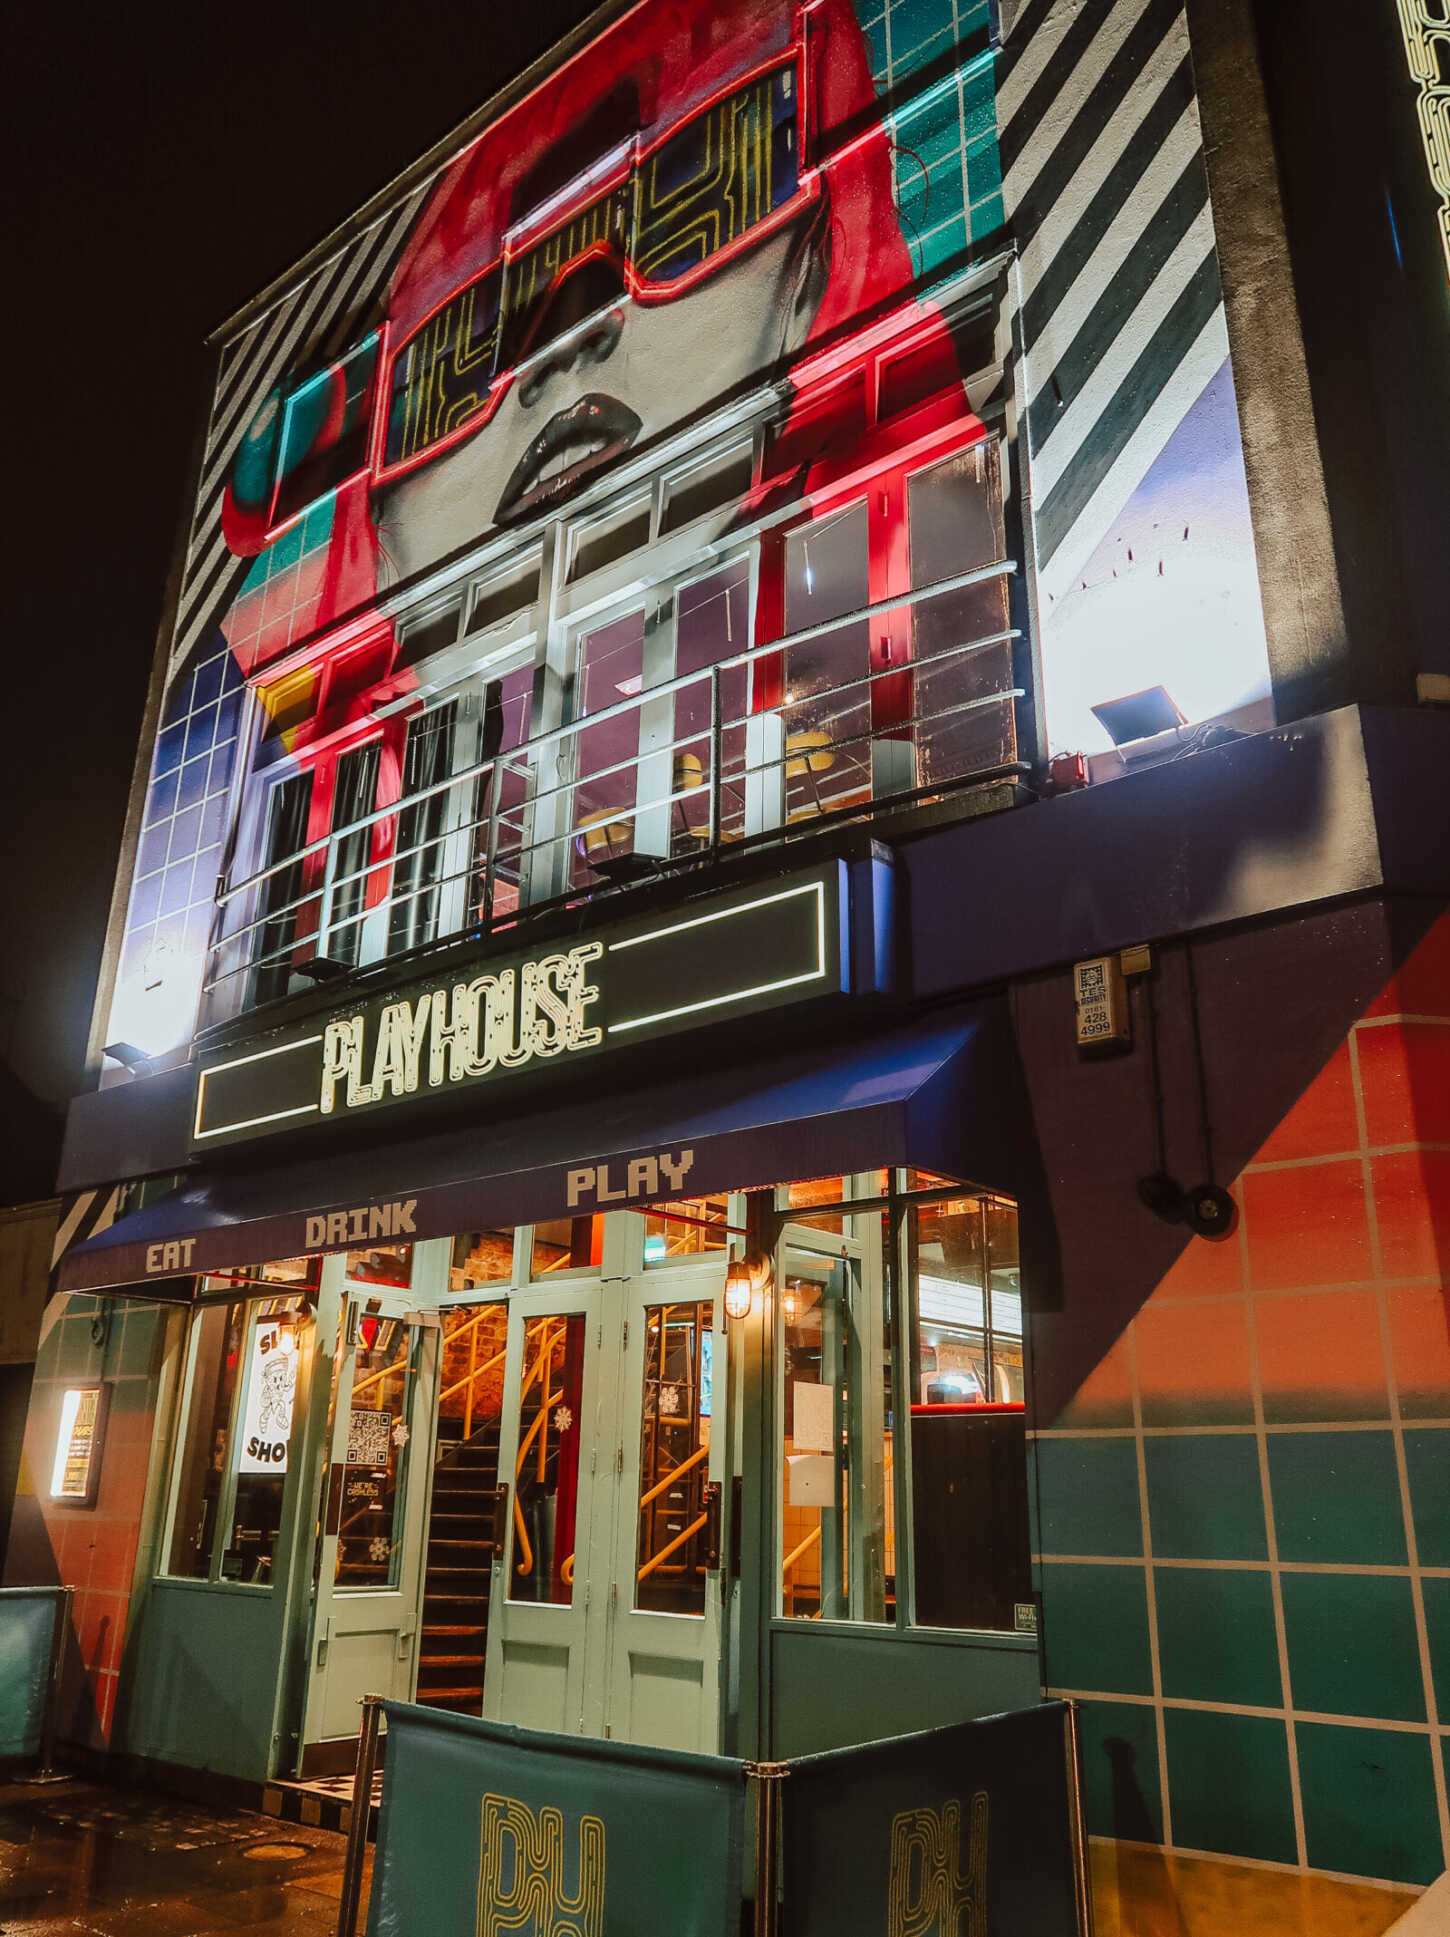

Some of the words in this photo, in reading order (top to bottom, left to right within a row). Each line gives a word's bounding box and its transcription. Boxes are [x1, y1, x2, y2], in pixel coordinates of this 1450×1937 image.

[320, 941, 603, 1114] PLAYHOUSE
[1080, 1021, 1110, 1036] 4999
[1084, 1011, 1107, 1024] 428
[145, 1238, 197, 1274] EAT
[305, 1199, 417, 1249] DRINK
[566, 1149, 694, 1207] PLAY
[247, 1437, 287, 1463] SHO
